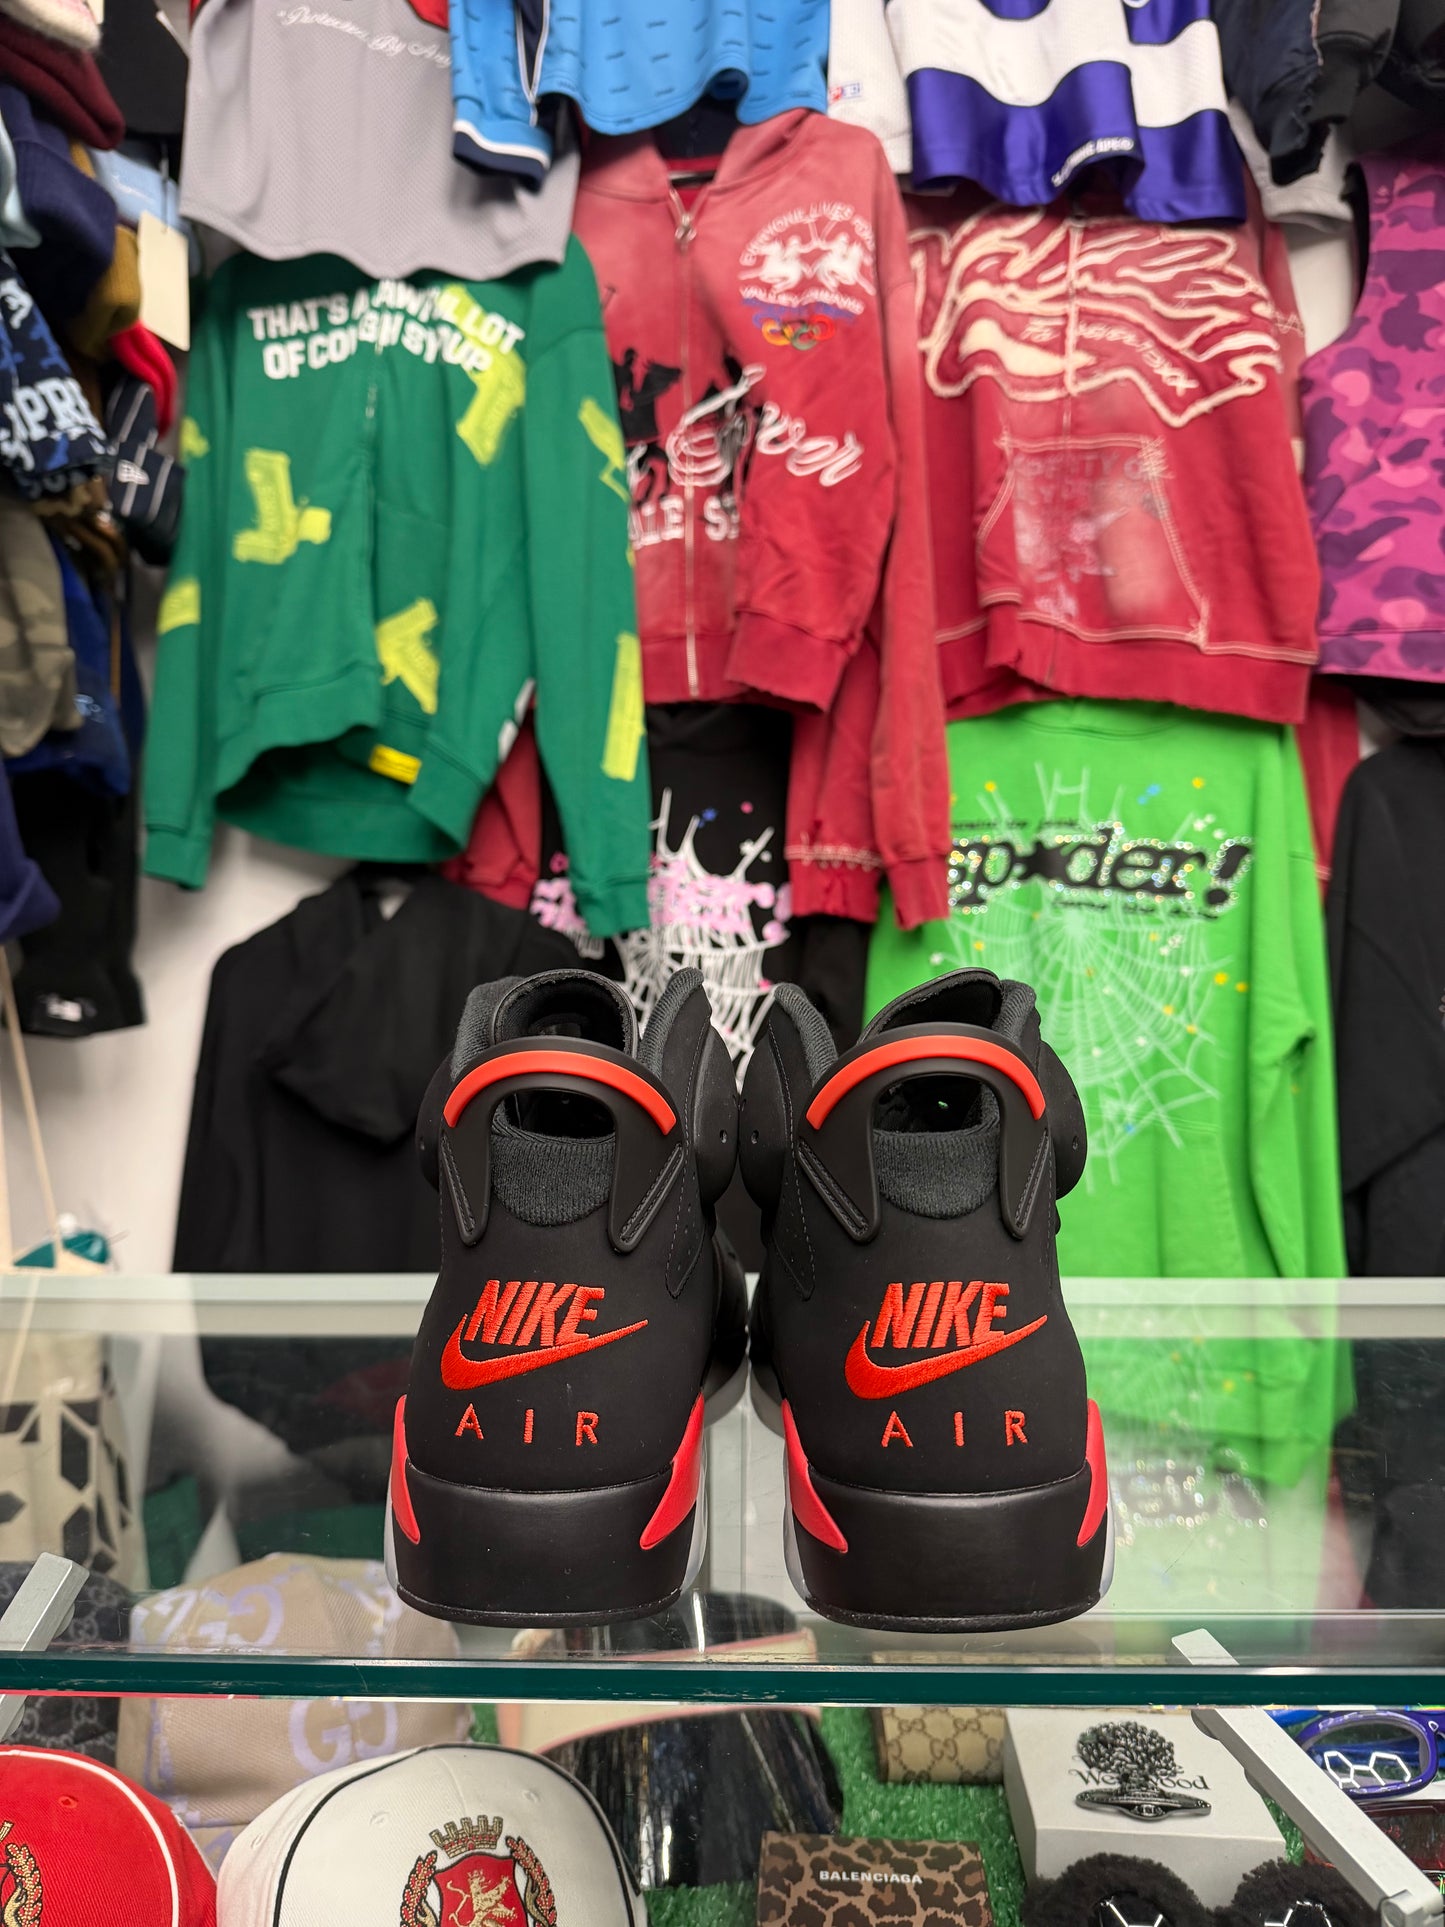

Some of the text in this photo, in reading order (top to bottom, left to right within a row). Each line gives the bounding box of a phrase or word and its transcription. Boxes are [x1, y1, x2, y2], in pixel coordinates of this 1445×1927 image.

[247, 292, 349, 341] THAT'S
[460, 305, 526, 356] LOT
[262, 340, 306, 380] OF
[464, 1279, 605, 1347] NIKE
[870, 1280, 1010, 1349] NIKE
[455, 1402, 599, 1447] AIR
[881, 1410, 1028, 1447] AIR
[819, 1870, 923, 1884] BALENCIAGA
